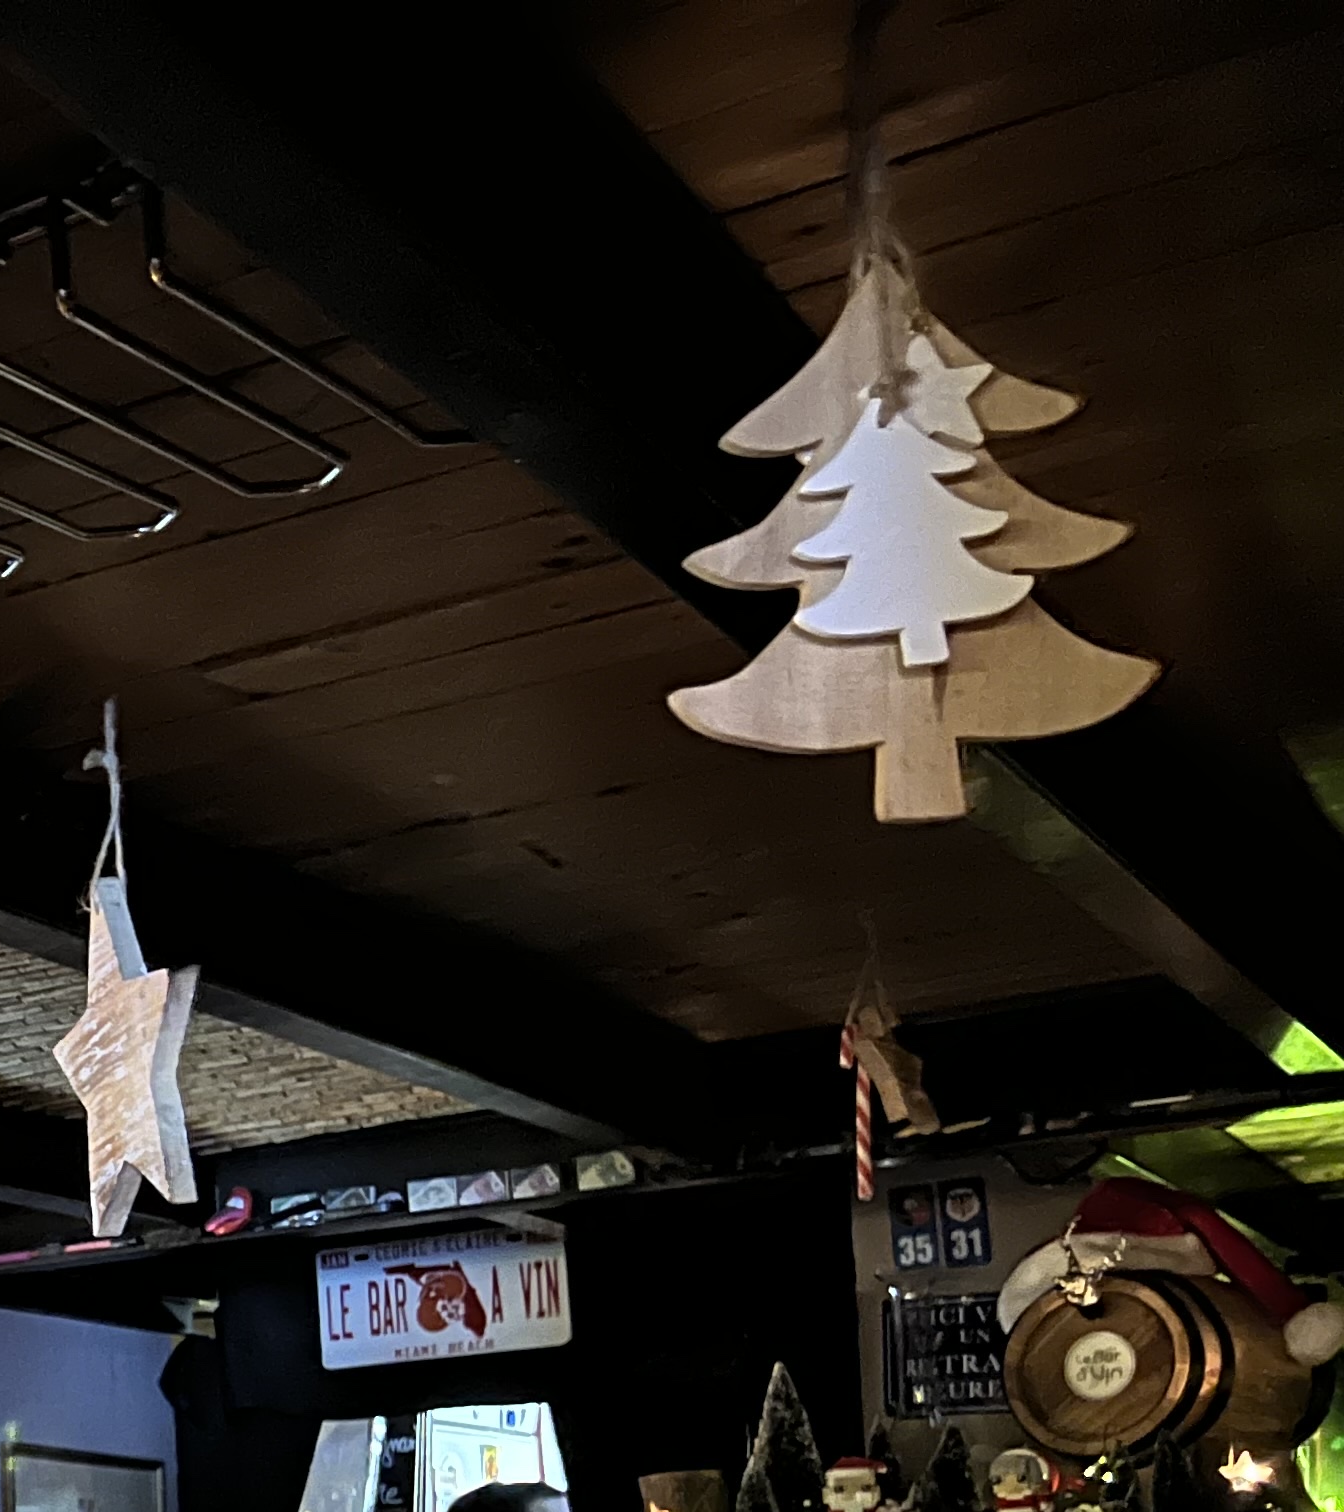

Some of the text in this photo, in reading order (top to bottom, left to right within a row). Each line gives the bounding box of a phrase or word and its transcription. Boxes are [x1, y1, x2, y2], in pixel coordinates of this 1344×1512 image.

[898, 1233, 933, 1266] 35
[950, 1227, 983, 1260] 31
[326, 1258, 561, 1341] LE BAR A VIN
[394, 1338, 494, 1358] MIAMI BEACH
